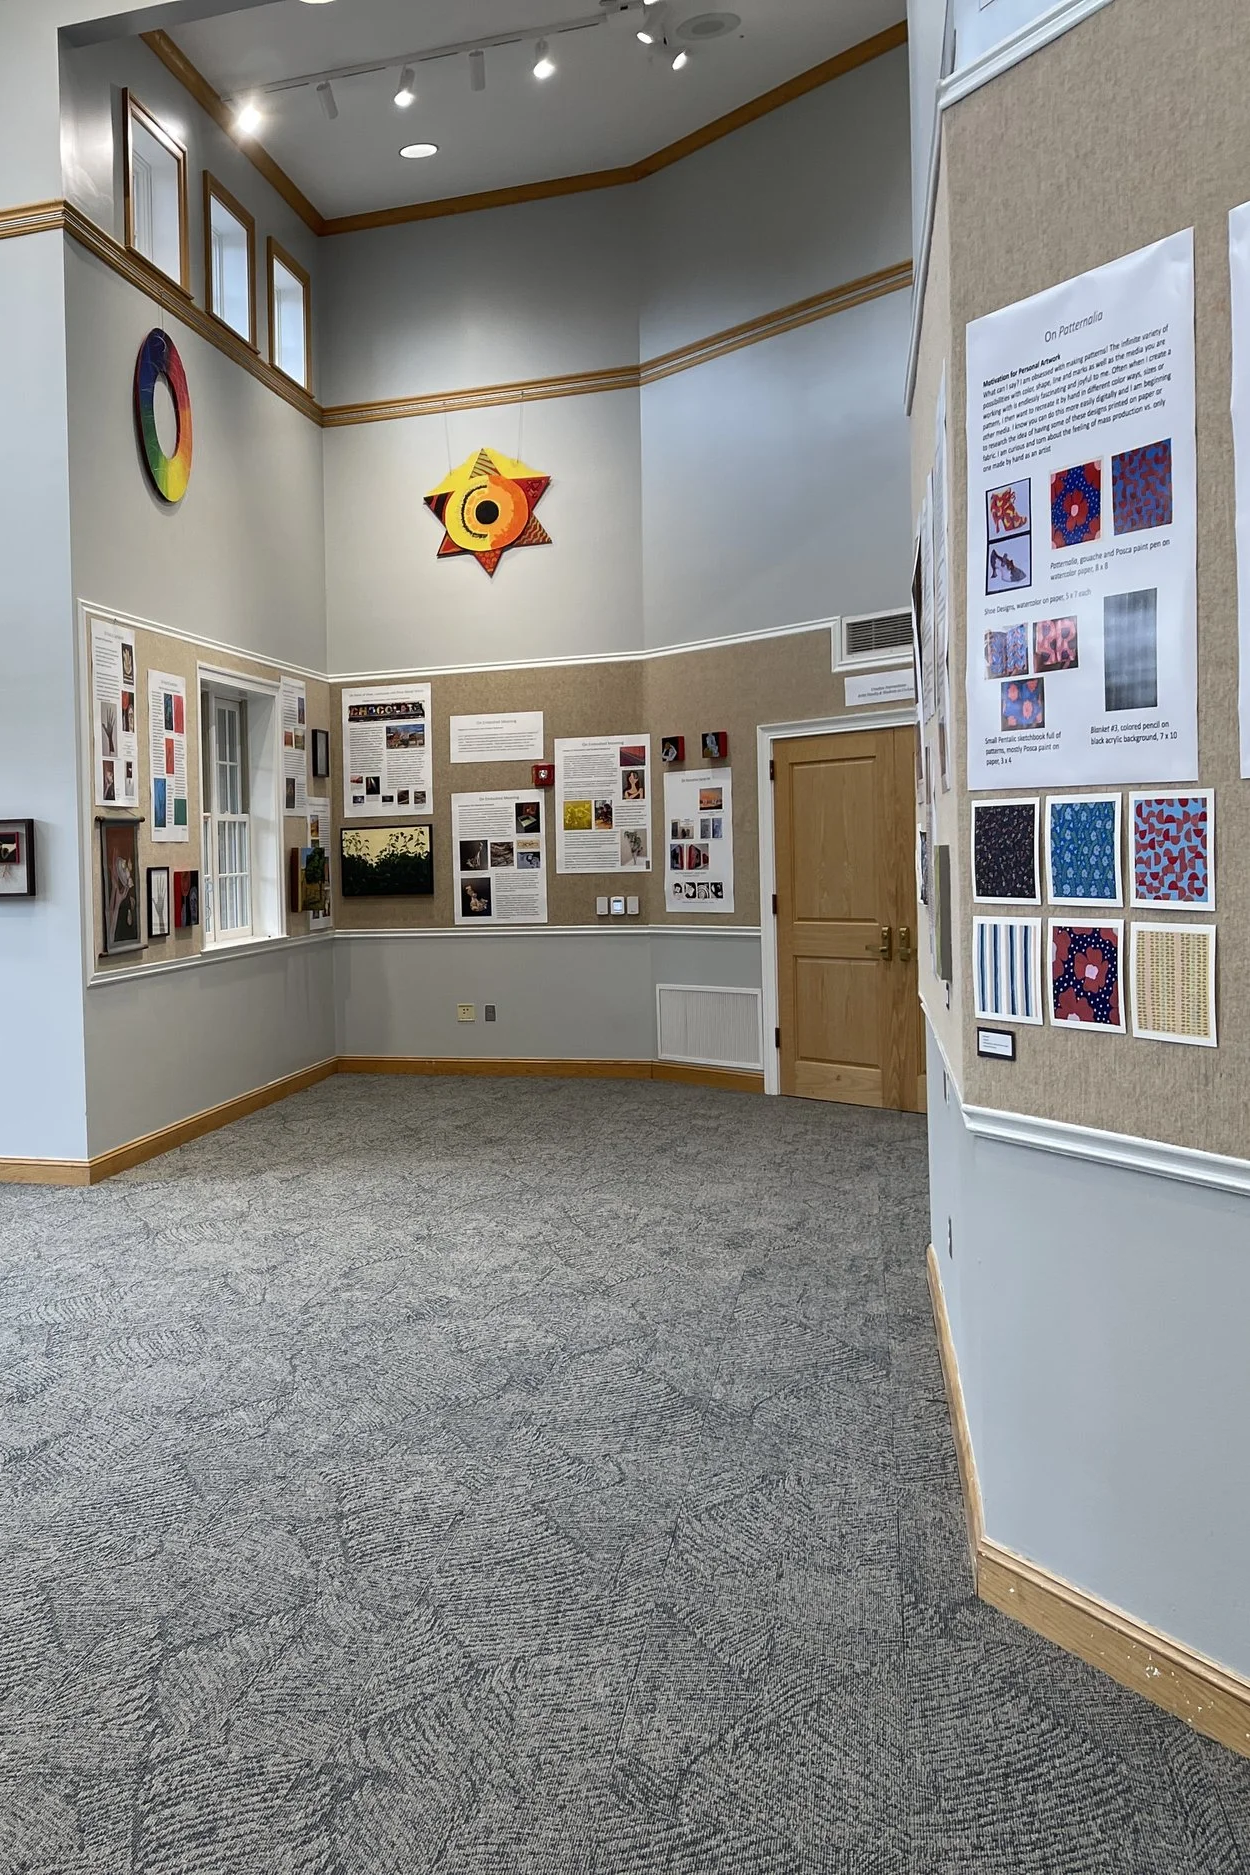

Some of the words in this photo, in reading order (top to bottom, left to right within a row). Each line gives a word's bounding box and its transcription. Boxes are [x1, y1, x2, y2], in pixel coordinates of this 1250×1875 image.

[1045, 330, 1057, 343] On
[1058, 311, 1103, 337] Patternalia
[983, 374, 1009, 388] Motivation
[1018, 361, 1040, 375] Personal
[1040, 353, 1060, 367] Artwork
